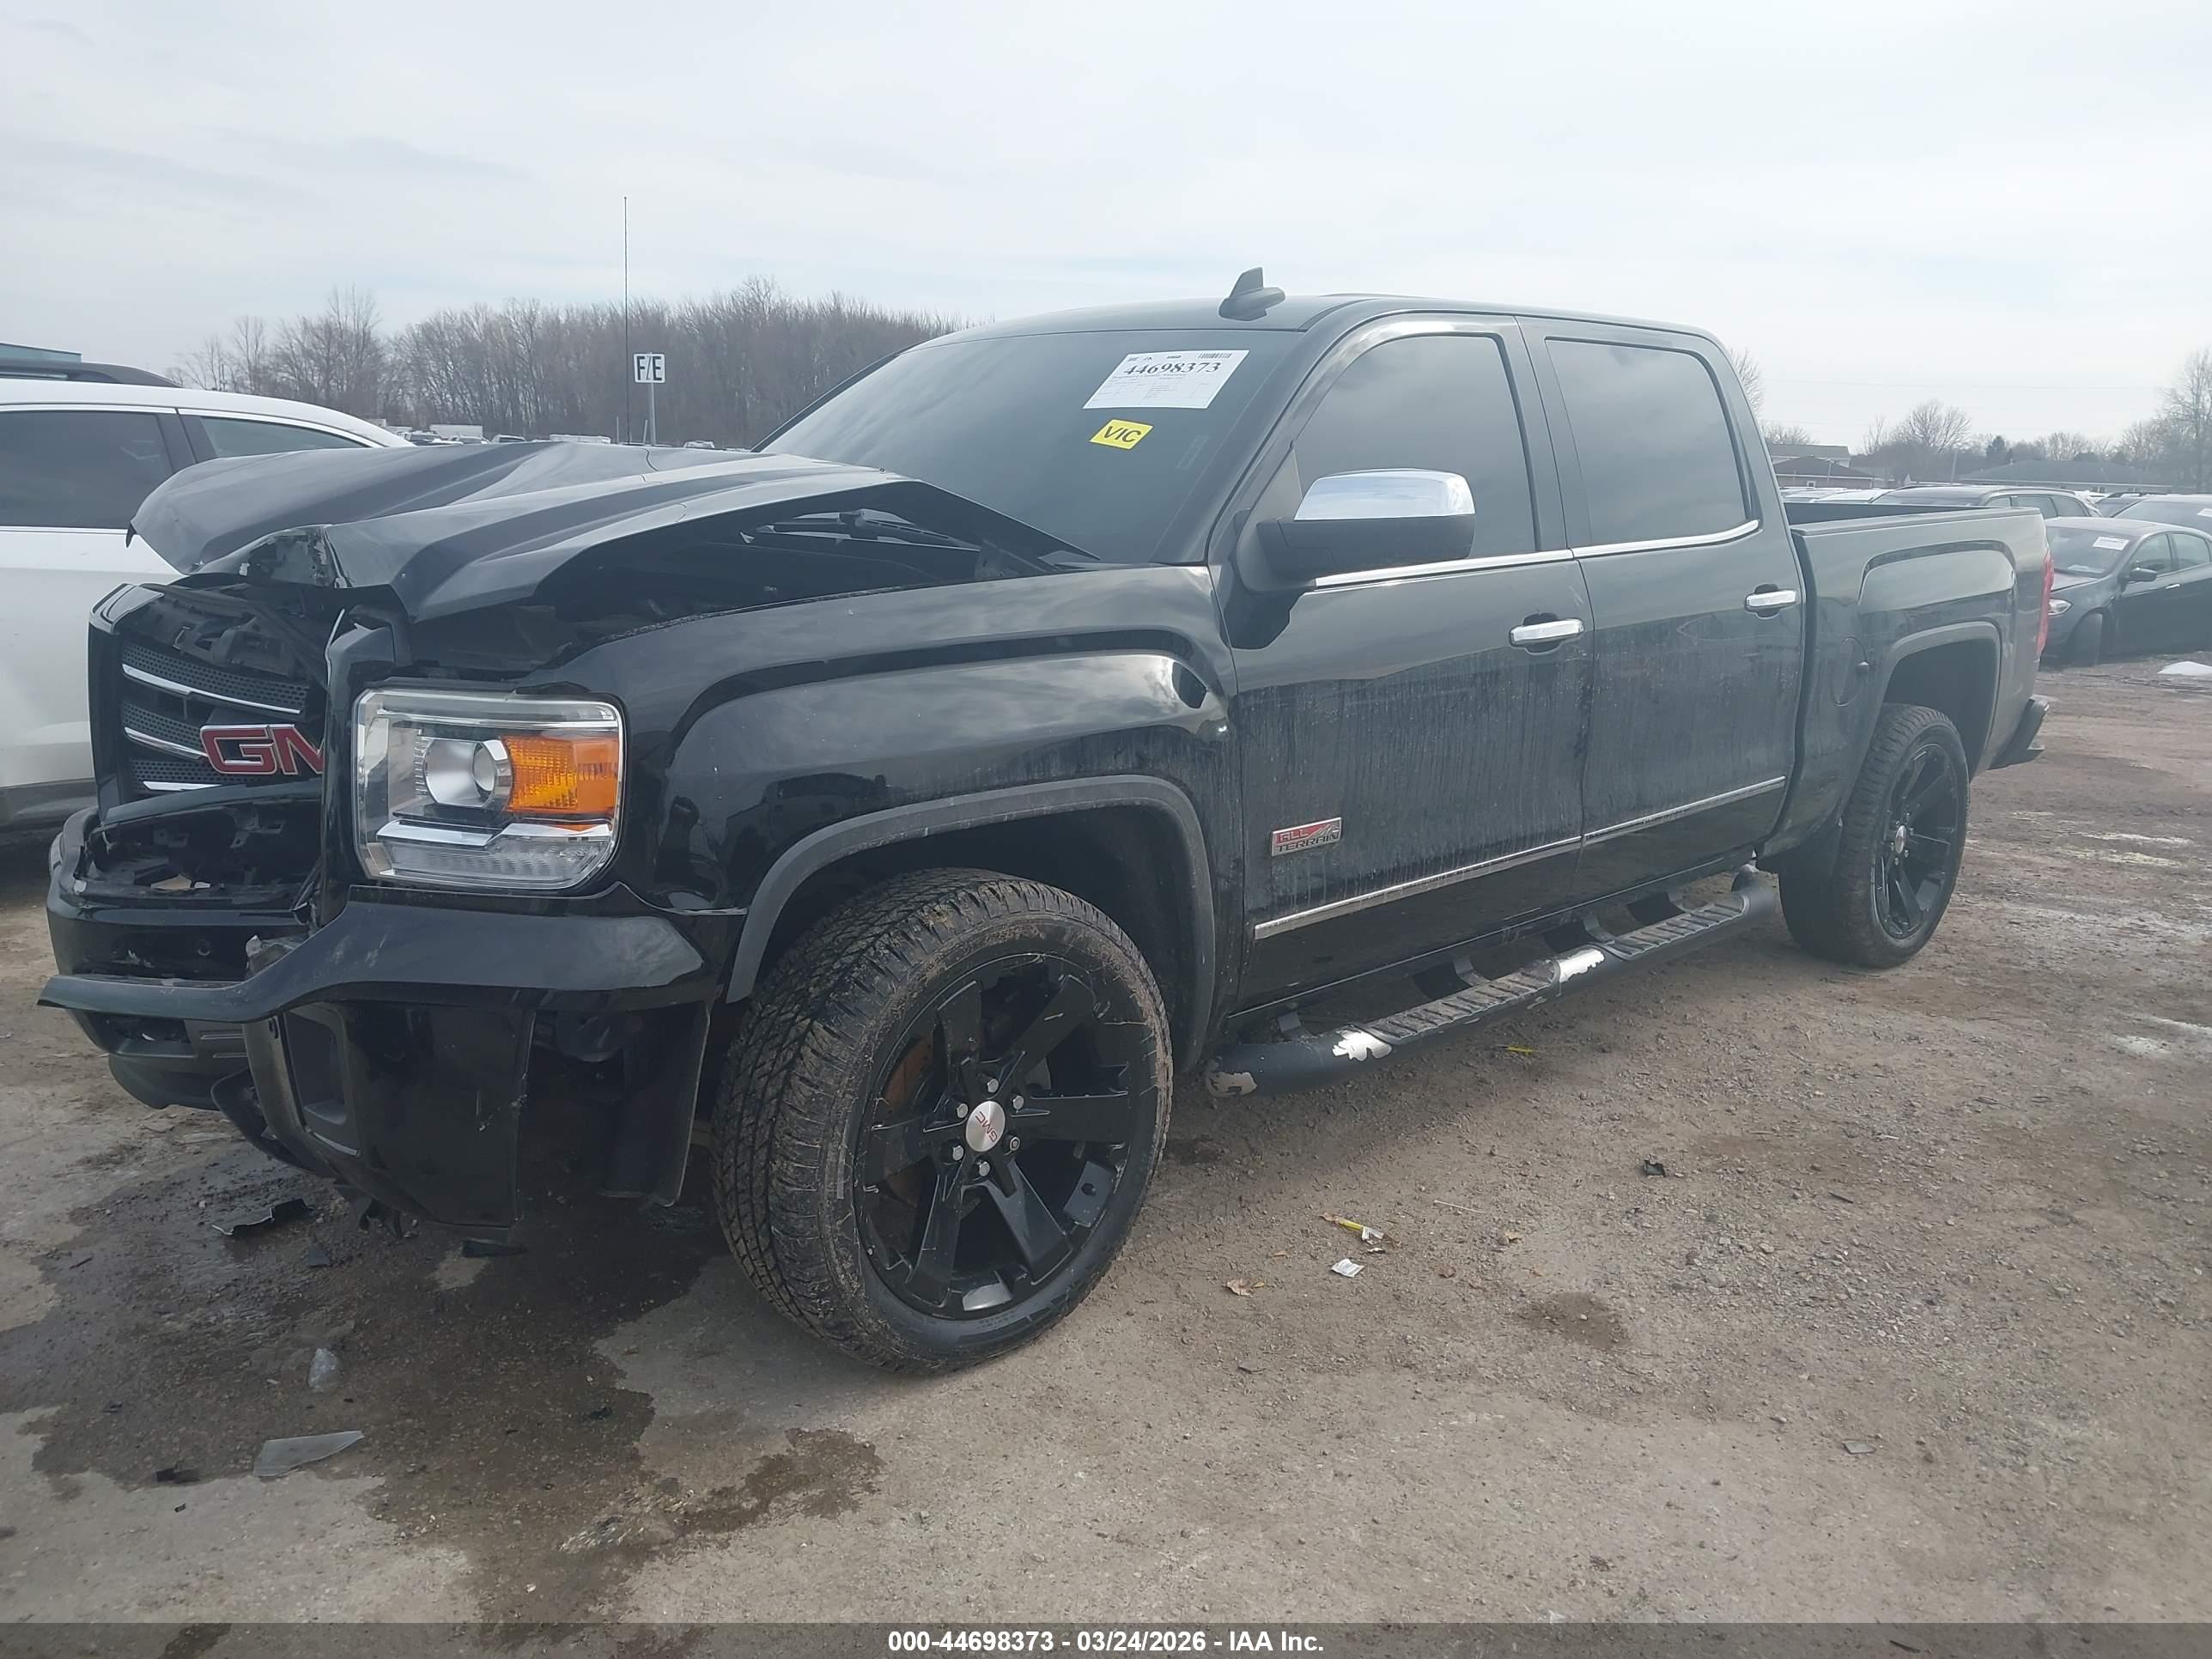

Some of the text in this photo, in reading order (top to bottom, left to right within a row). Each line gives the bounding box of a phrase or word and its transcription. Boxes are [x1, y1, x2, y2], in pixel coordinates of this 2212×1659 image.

[636, 356, 663, 380] F/E
[1123, 362, 1222, 375] 44698373
[1103, 425, 1142, 443] VIC
[1278, 832, 1340, 852] TERRAIN
[1279, 829, 1309, 842] ALL
[975, 1110, 998, 1143] GMC
